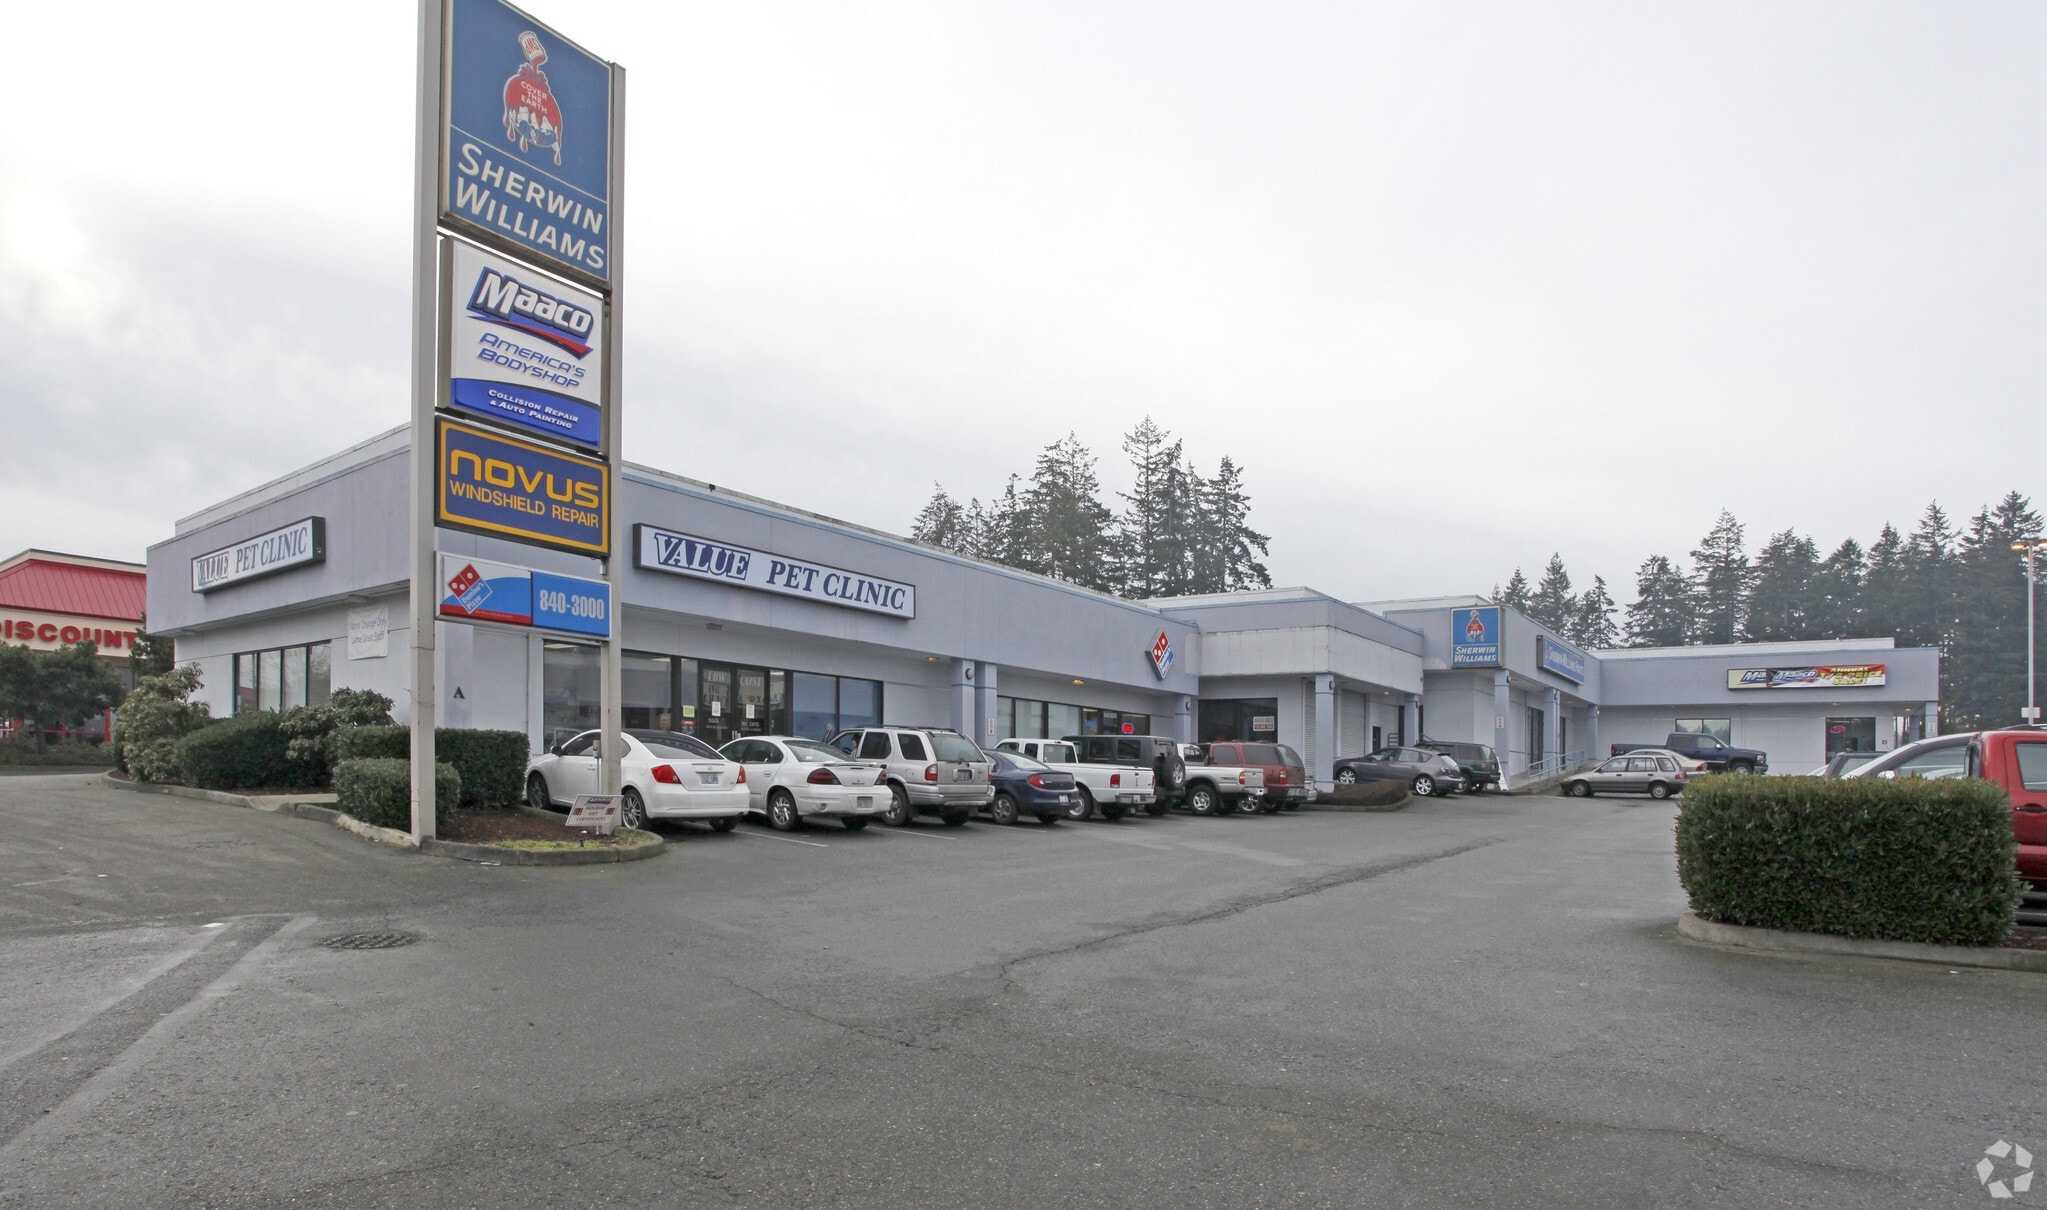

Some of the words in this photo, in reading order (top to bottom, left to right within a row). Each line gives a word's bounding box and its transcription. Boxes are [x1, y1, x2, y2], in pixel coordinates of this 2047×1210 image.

[521, 81, 547, 100] COVER
[521, 95, 548, 114] EARTH
[526, 91, 543, 105] THE
[457, 143, 603, 235] SHERWIN
[456, 176, 604, 269] WILLIAMS
[471, 269, 594, 340] Maaco
[477, 348, 580, 388] BODYSHOP
[479, 332, 586, 378] AMERICA'S
[488, 389, 541, 411] COLLISION
[544, 406, 579, 423] REPAIR
[498, 401, 525, 415] AUTO
[528, 410, 573, 429] PAINTING
[449, 479, 546, 516] WINDSHIELD
[551, 504, 599, 528] REPAIR
[196, 550, 229, 587] VALUE
[234, 543, 259, 574] PET
[260, 526, 307, 566] CLINIC
[654, 532, 751, 580] VALUE
[766, 560, 820, 592] PET
[823, 573, 906, 610] CLINIC
[461, 582, 485, 604] Domino's
[466, 596, 481, 611] Pizza
[539, 589, 605, 620] 840-3000
[0, 619, 138, 649] ISCOUNT
[1454, 654, 1497, 662] WILLIAMS
[1455, 646, 1496, 655] SHERWIN
[1772, 670, 1818, 681] Maaco
[452, 686, 465, 699] A
